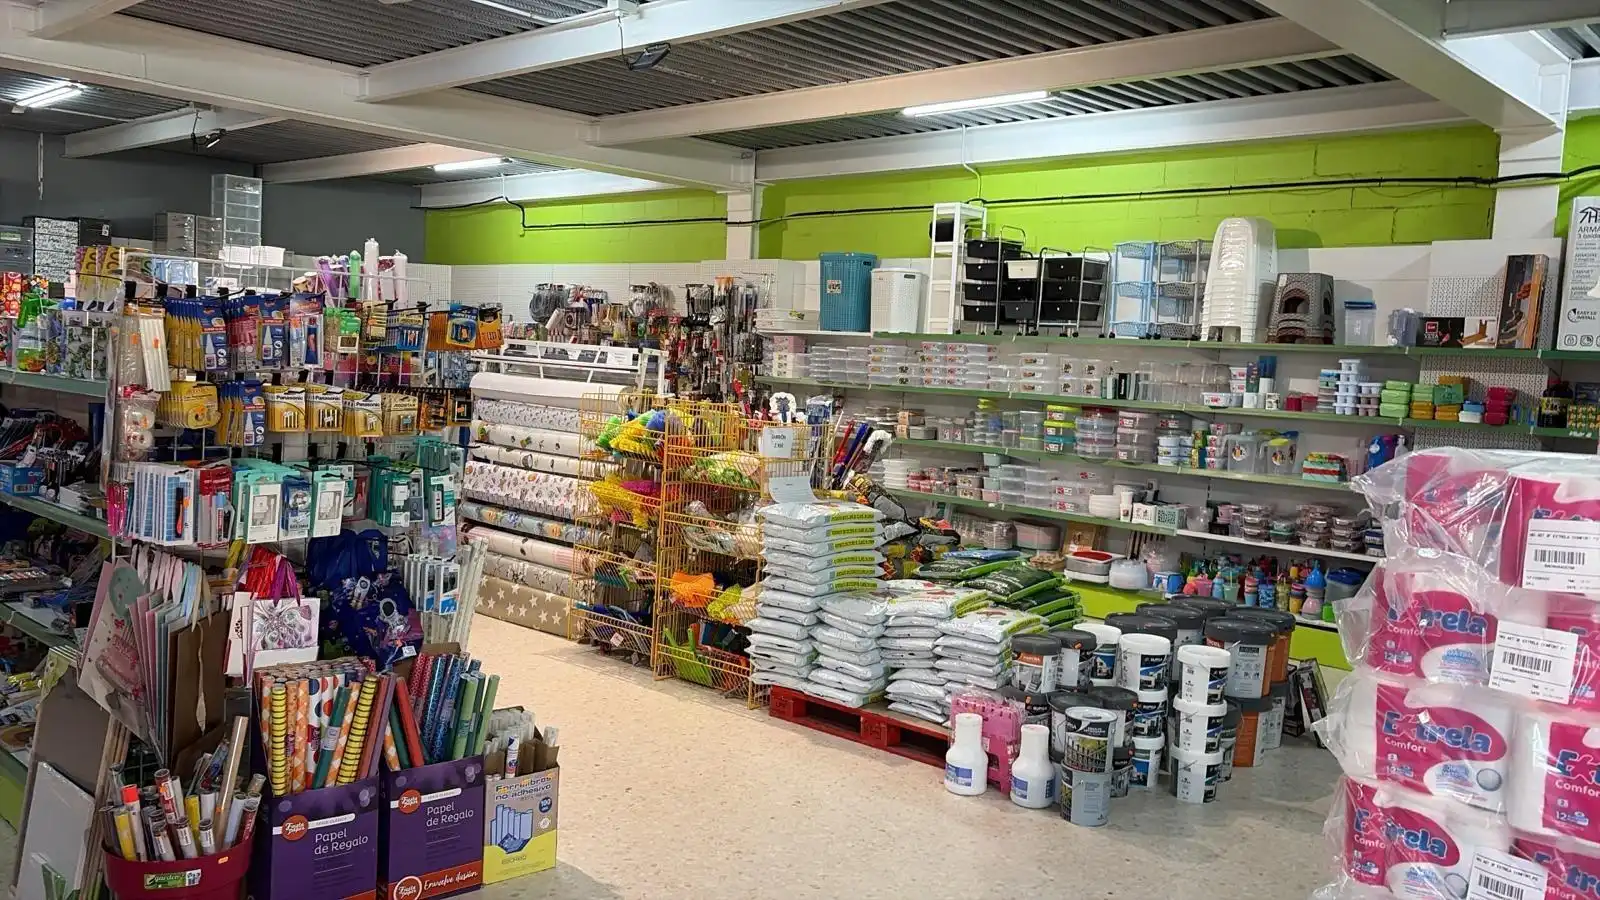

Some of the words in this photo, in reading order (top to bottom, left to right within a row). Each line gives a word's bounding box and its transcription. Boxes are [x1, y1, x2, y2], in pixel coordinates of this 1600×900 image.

[1384, 735, 1428, 754] Comfort
[495, 793, 509, 801] no
[510, 784, 552, 798] adhesivo
[426, 802, 455, 816] Papel
[426, 817, 440, 827] de
[441, 808, 475, 824] Regalo
[314, 844, 330, 855] de
[331, 835, 369, 852] Regalo
[315, 828, 348, 844] Papel
